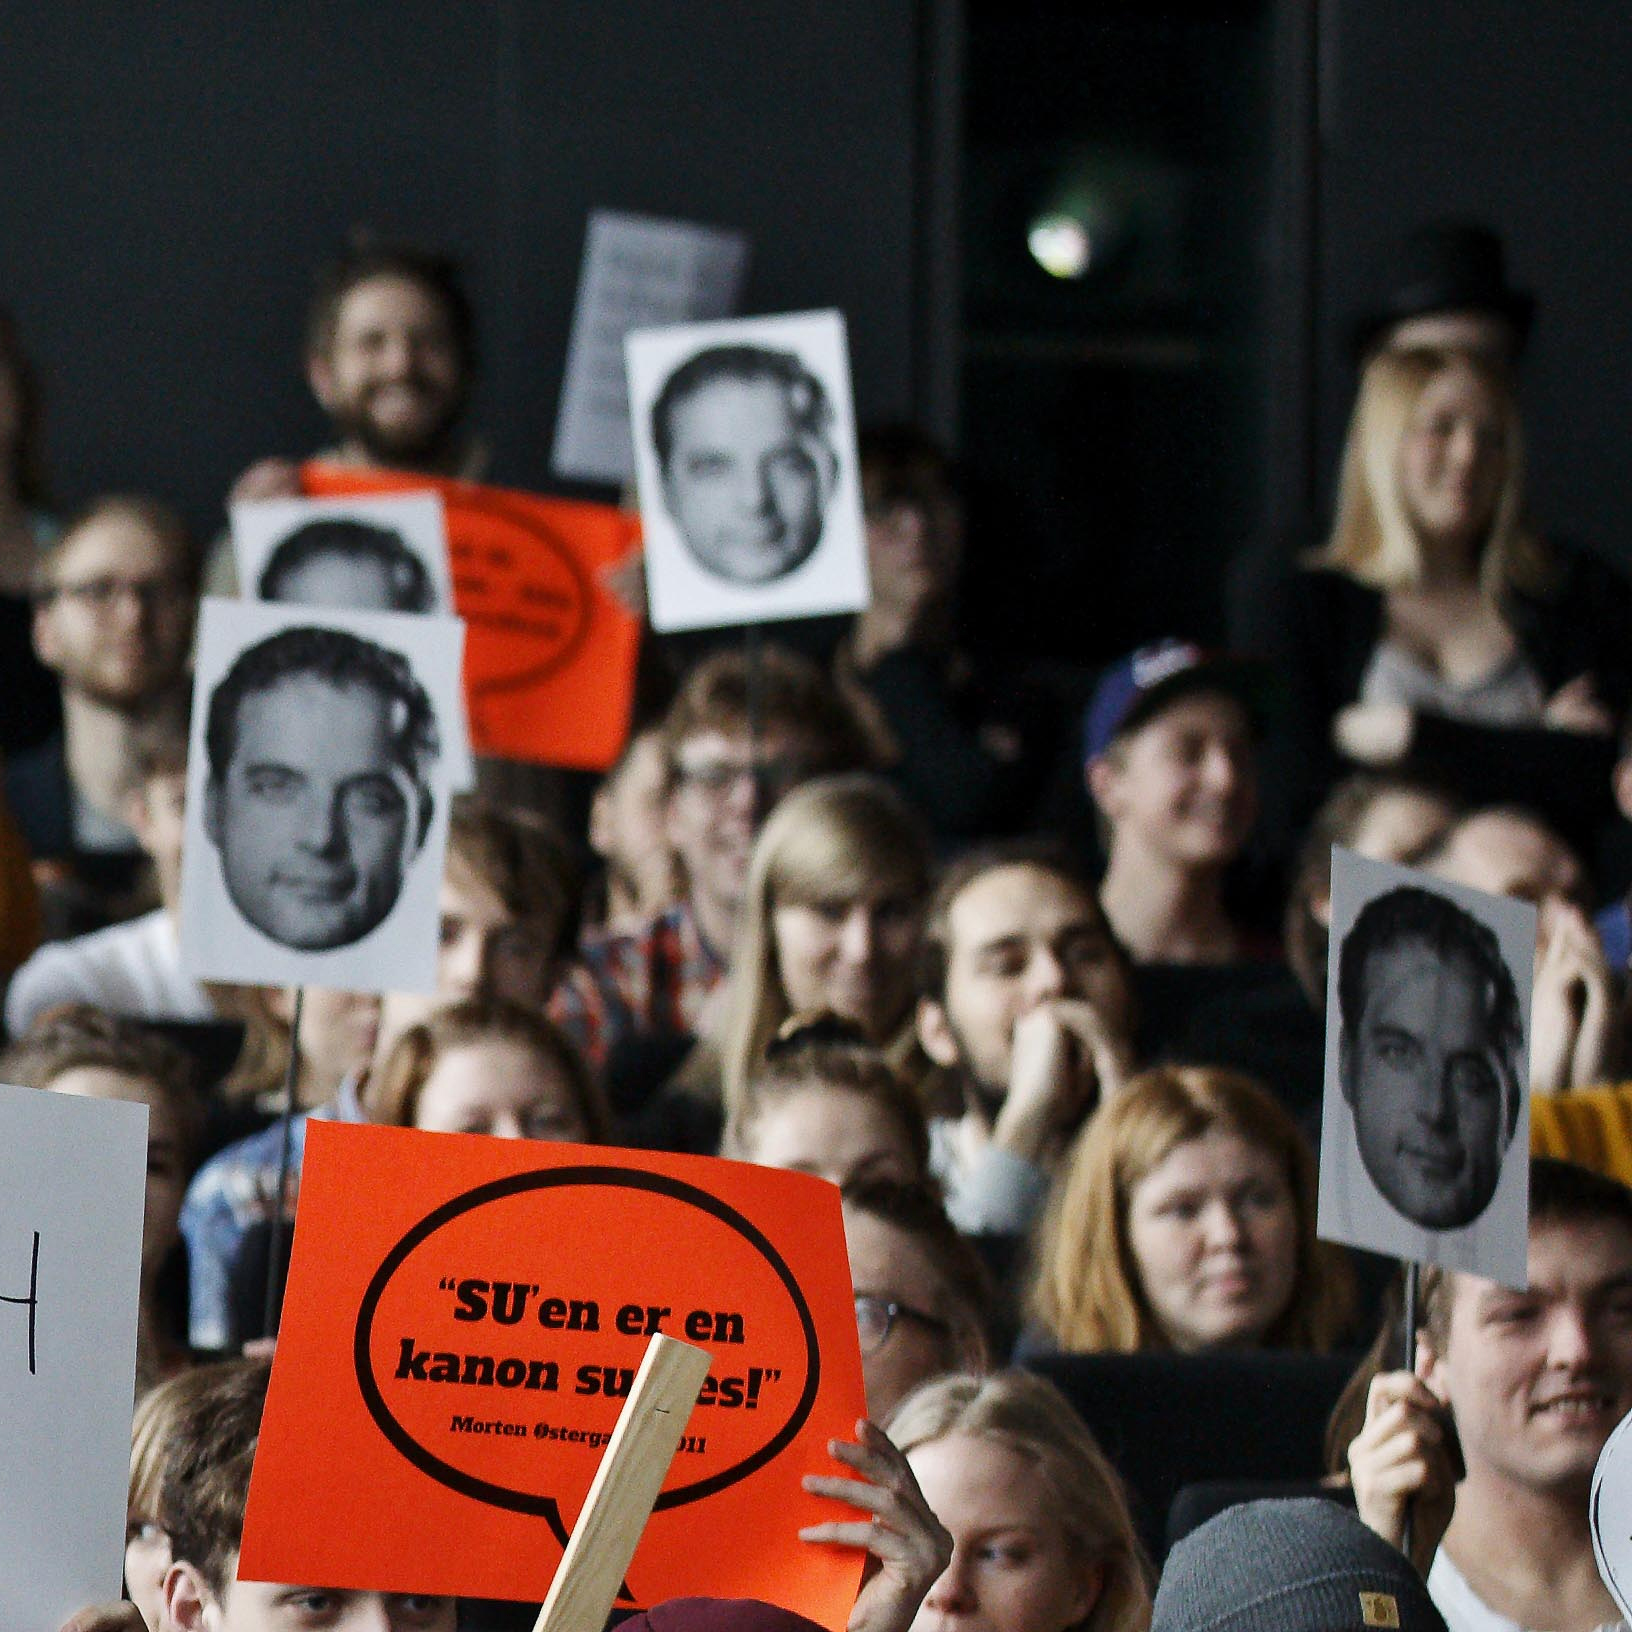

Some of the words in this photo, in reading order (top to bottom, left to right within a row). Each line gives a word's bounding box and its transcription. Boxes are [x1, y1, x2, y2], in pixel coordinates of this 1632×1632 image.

[615, 1304, 672, 1336] er
[684, 1309, 745, 1344] en
[394, 1338, 560, 1392] kanon
[449, 1415, 527, 1437] Morten
[533, 1422, 612, 1448] Østerga
